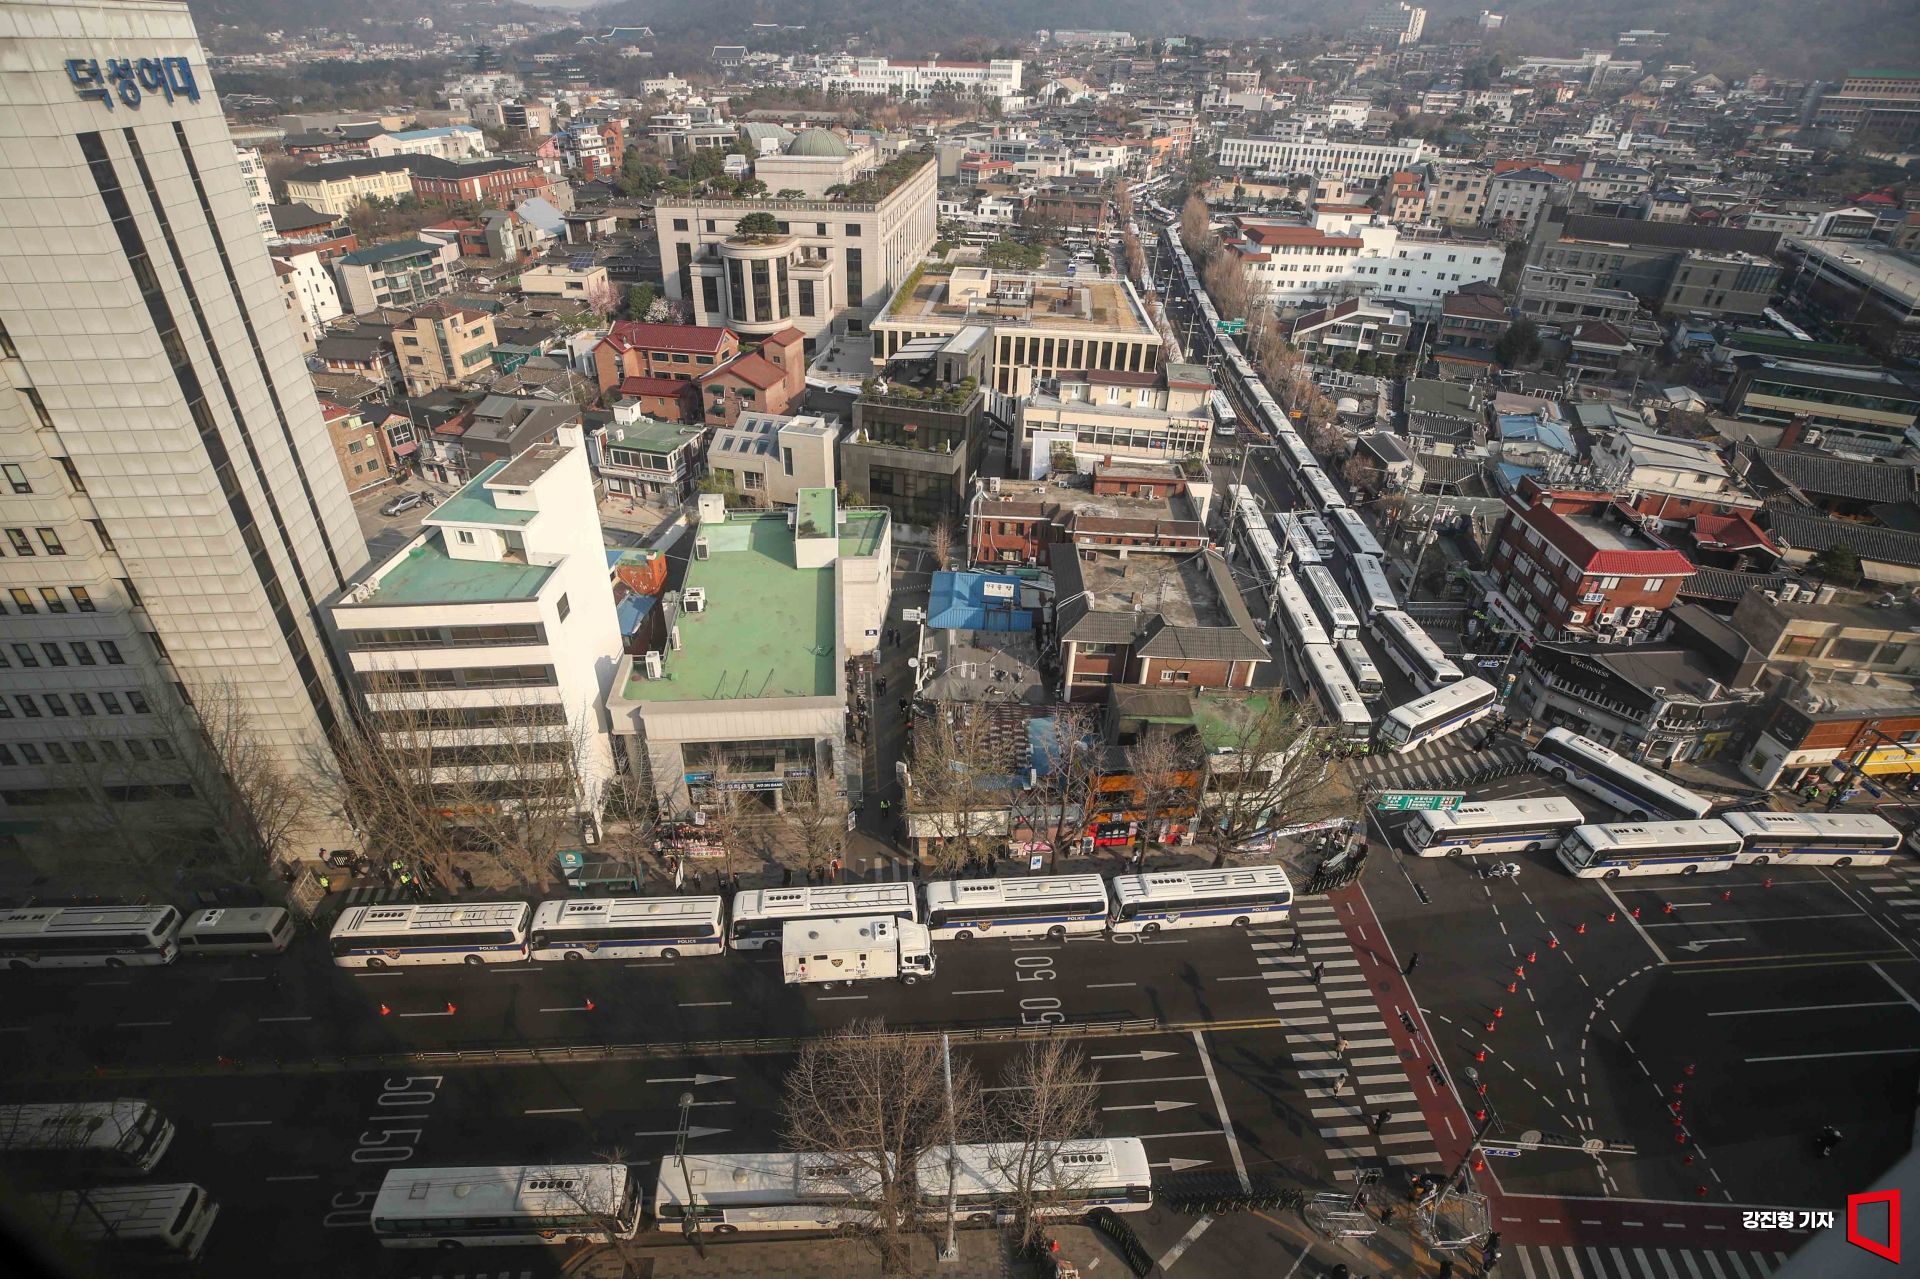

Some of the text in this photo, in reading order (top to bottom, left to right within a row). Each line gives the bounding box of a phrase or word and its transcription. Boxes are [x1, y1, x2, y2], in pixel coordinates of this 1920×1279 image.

[64, 56, 201, 113] 덕성여대
[1576, 660, 1609, 678] GUINNESS
[1014, 956, 1057, 983] 50
[1019, 997, 1066, 1025] 50
[378, 1076, 444, 1106] 50
[351, 1129, 423, 1163] 50
